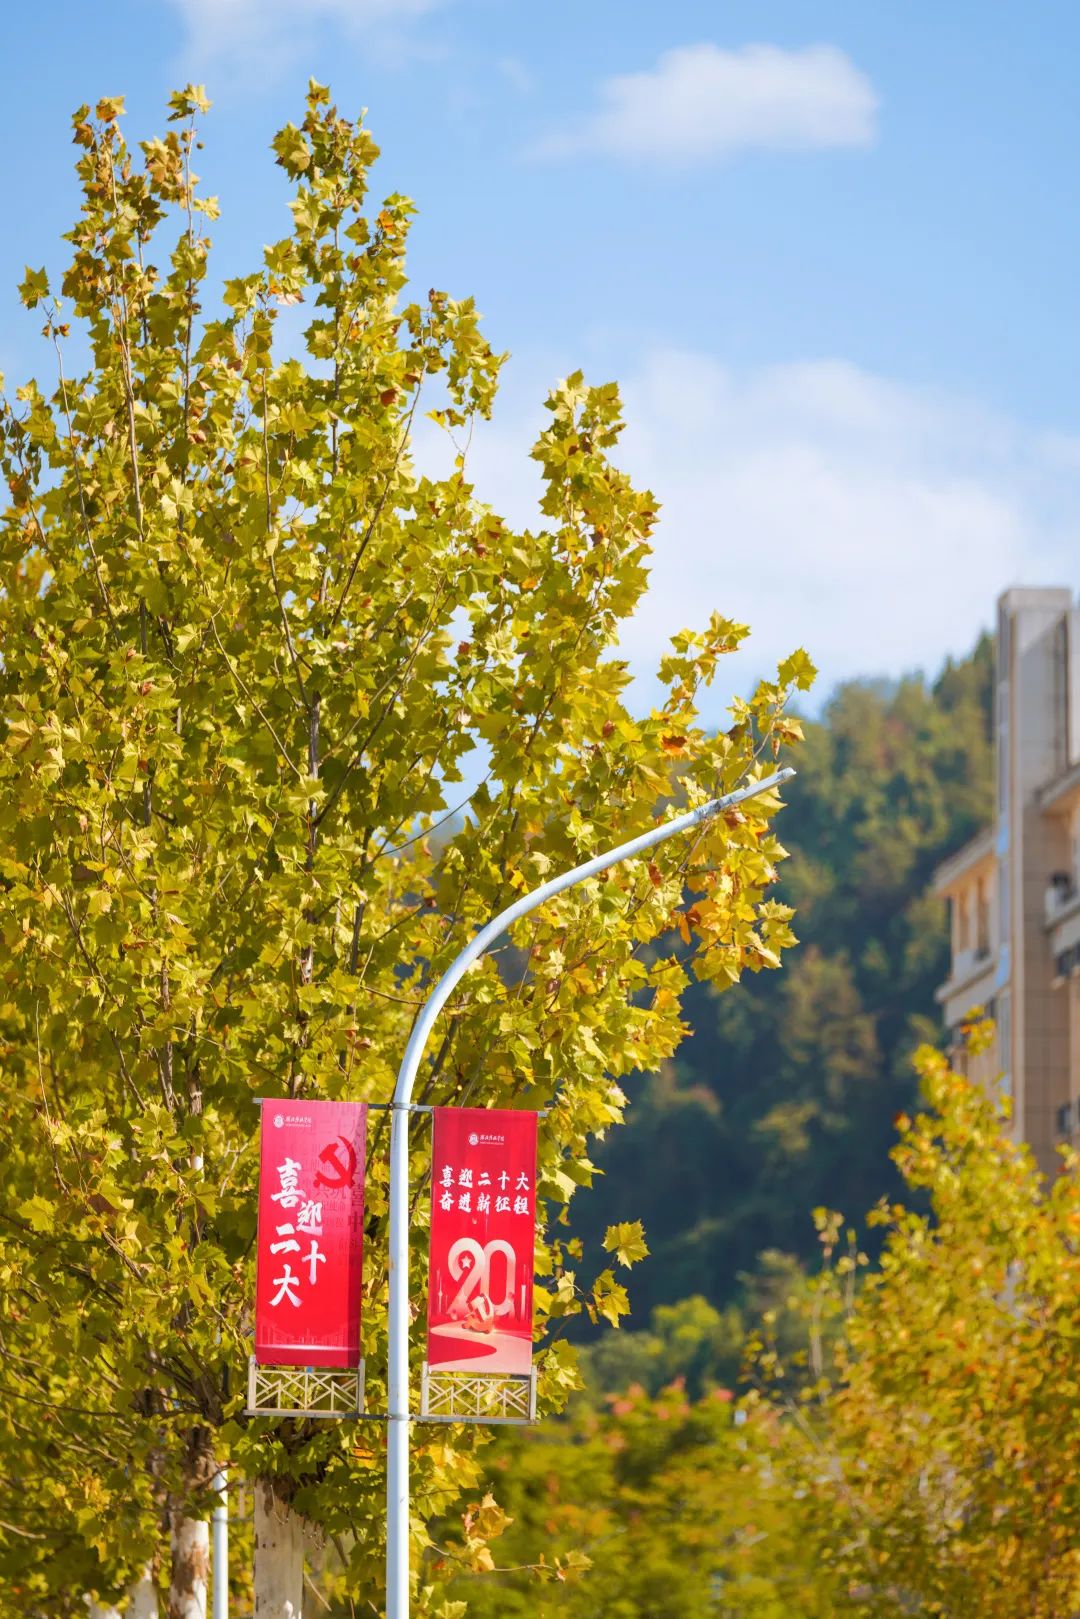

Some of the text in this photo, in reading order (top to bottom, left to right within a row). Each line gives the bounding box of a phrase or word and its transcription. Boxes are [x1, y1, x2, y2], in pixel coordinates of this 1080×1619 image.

[439, 1165, 530, 1191] 喜迎二十大
[269, 1157, 327, 1308] 喜迎二十大
[447, 1237, 516, 1318] 20
